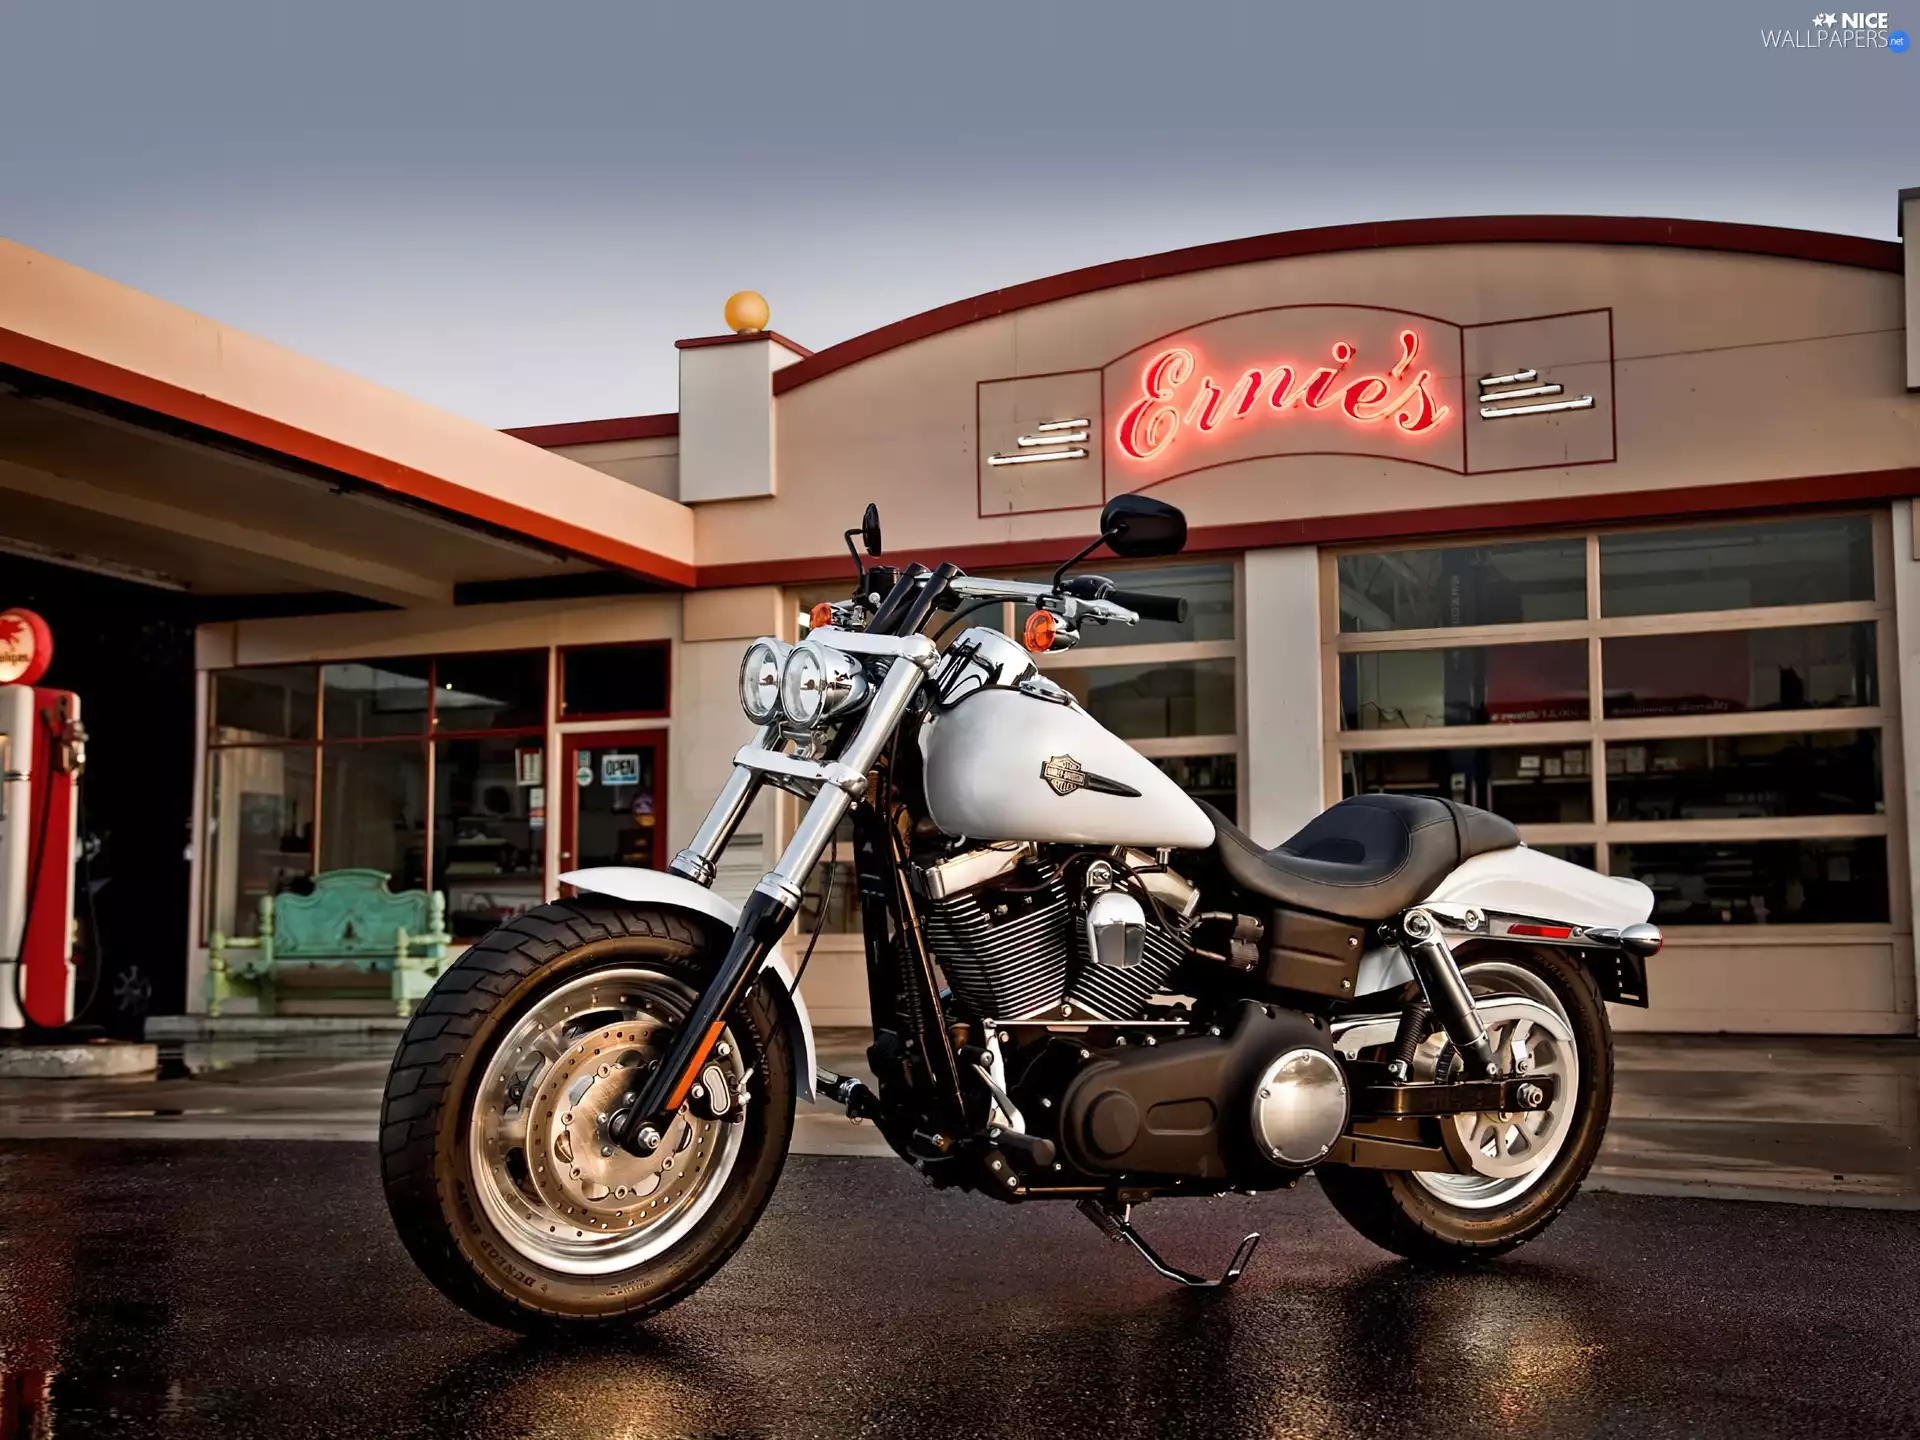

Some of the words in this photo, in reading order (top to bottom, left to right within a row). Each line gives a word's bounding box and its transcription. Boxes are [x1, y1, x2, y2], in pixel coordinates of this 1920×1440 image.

[1117, 329, 1450, 459] Ernie's
[606, 759, 636, 776] OPEN
[480, 1240, 537, 1288] DUNLOP
